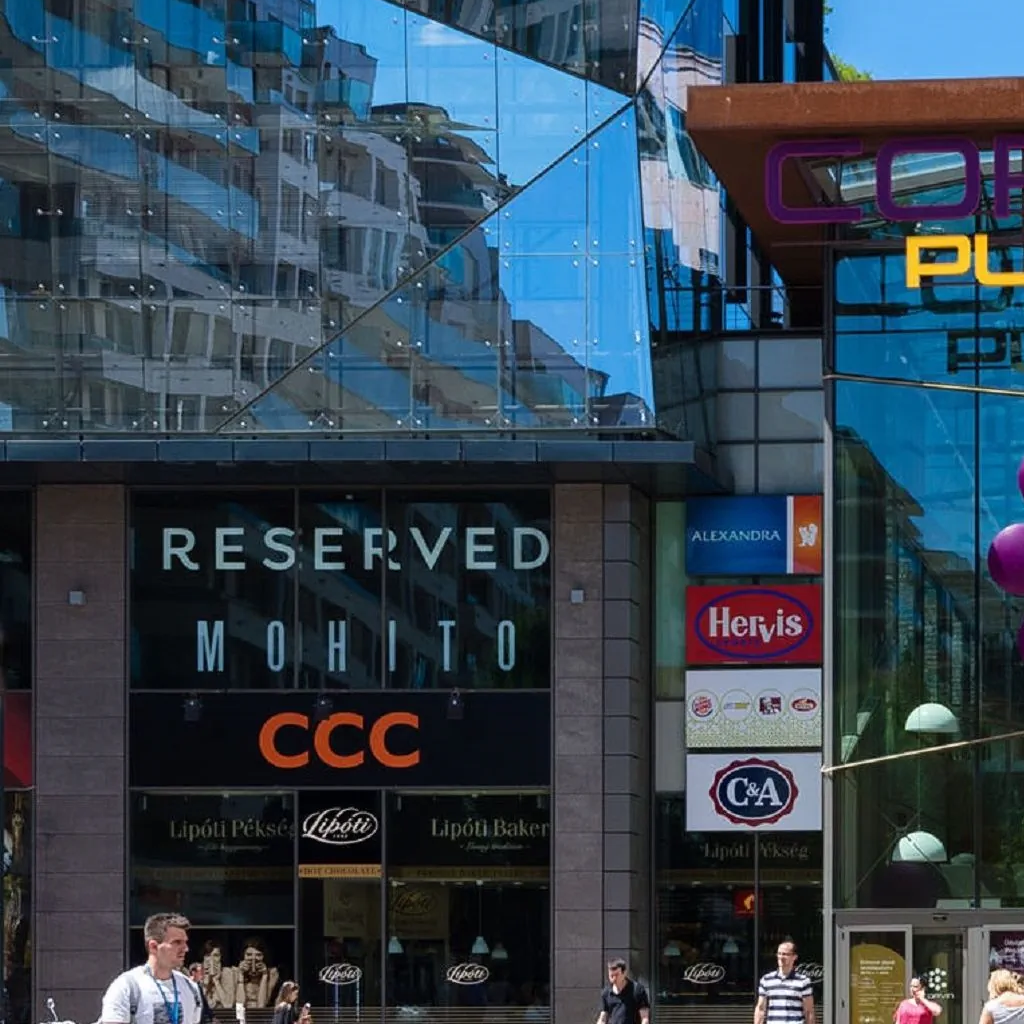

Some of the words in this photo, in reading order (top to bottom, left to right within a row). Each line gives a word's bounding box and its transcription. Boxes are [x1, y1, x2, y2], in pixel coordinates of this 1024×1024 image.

[162, 527, 549, 570] RESERVED
[691, 530, 781, 542] ALEXANDRA
[708, 606, 803, 643] Hervis
[197, 620, 516, 672] MOHITO
[258, 712, 420, 769] CCC
[726, 777, 783, 806] C&A
[170, 817, 227, 842] Lipóti
[302, 807, 378, 844] Lipóti
[431, 817, 488, 842] Lipóti
